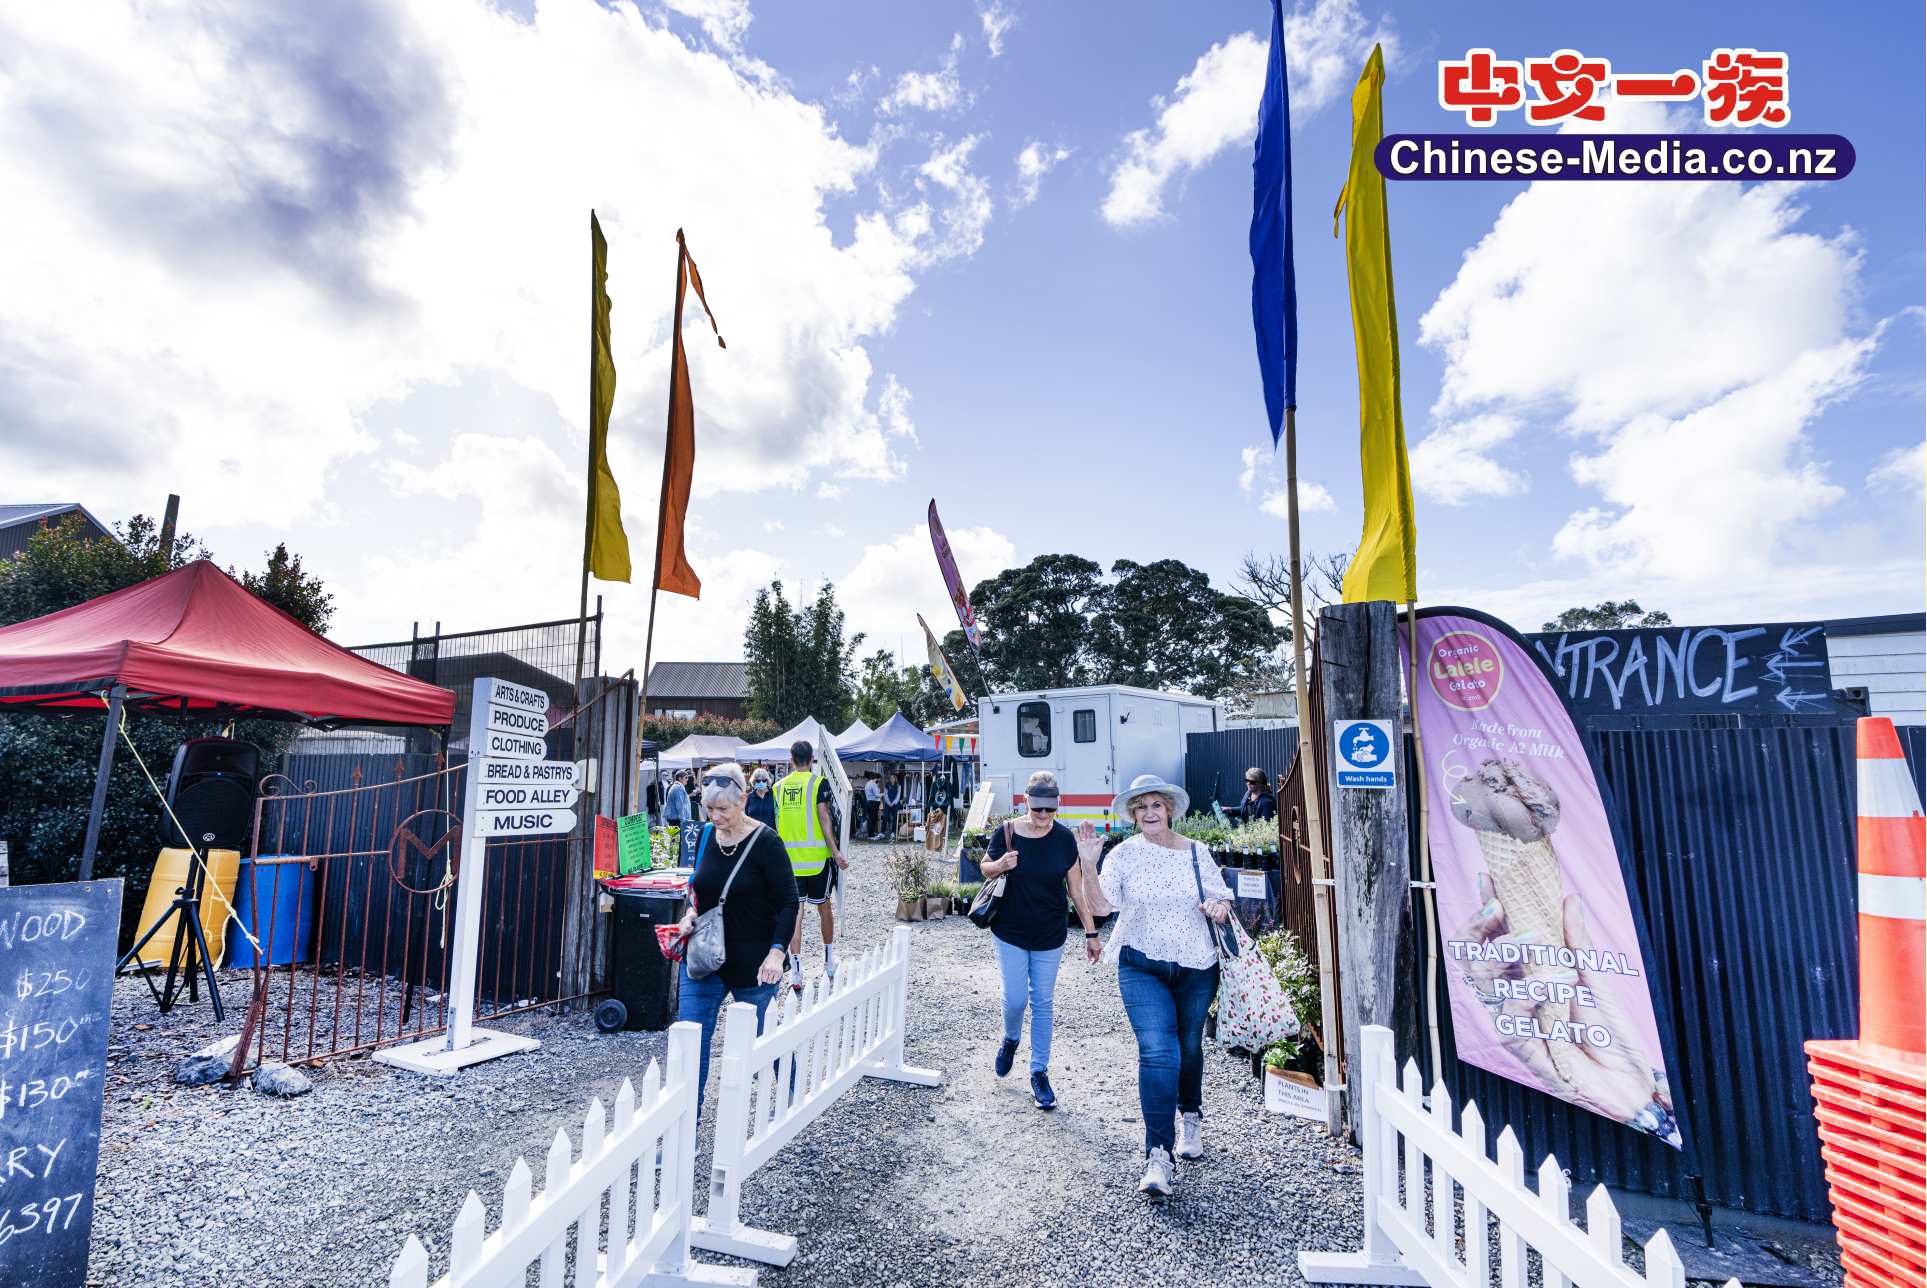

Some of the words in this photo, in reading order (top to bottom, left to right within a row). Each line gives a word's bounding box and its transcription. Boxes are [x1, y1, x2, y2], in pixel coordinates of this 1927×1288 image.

[1438, 645, 1480, 658] Organic
[495, 685, 514, 701] ARTS
[515, 692, 520, 703] &
[520, 691, 545, 709] CRAFTS
[494, 710, 545, 732] PRODUCE
[1471, 720, 1505, 735] Made
[1507, 724, 1542, 739] from
[492, 736, 542, 756] CLOTHING
[1452, 733, 1505, 752] Organic
[1508, 743, 1526, 754] A2
[1529, 743, 1565, 759] Milk
[487, 764, 521, 779] BREAD
[523, 765, 530, 779] &
[532, 765, 573, 780] PASTRYS
[1365, 775, 1388, 783] hands
[485, 789, 527, 804] FOOD
[530, 789, 571, 804] ALLEY
[494, 814, 553, 830] MUSIC
[1448, 940, 1640, 977] TRADITIONAL
[1493, 978, 1597, 1008] RECIPE
[1495, 1014, 1612, 1048] GELATO
